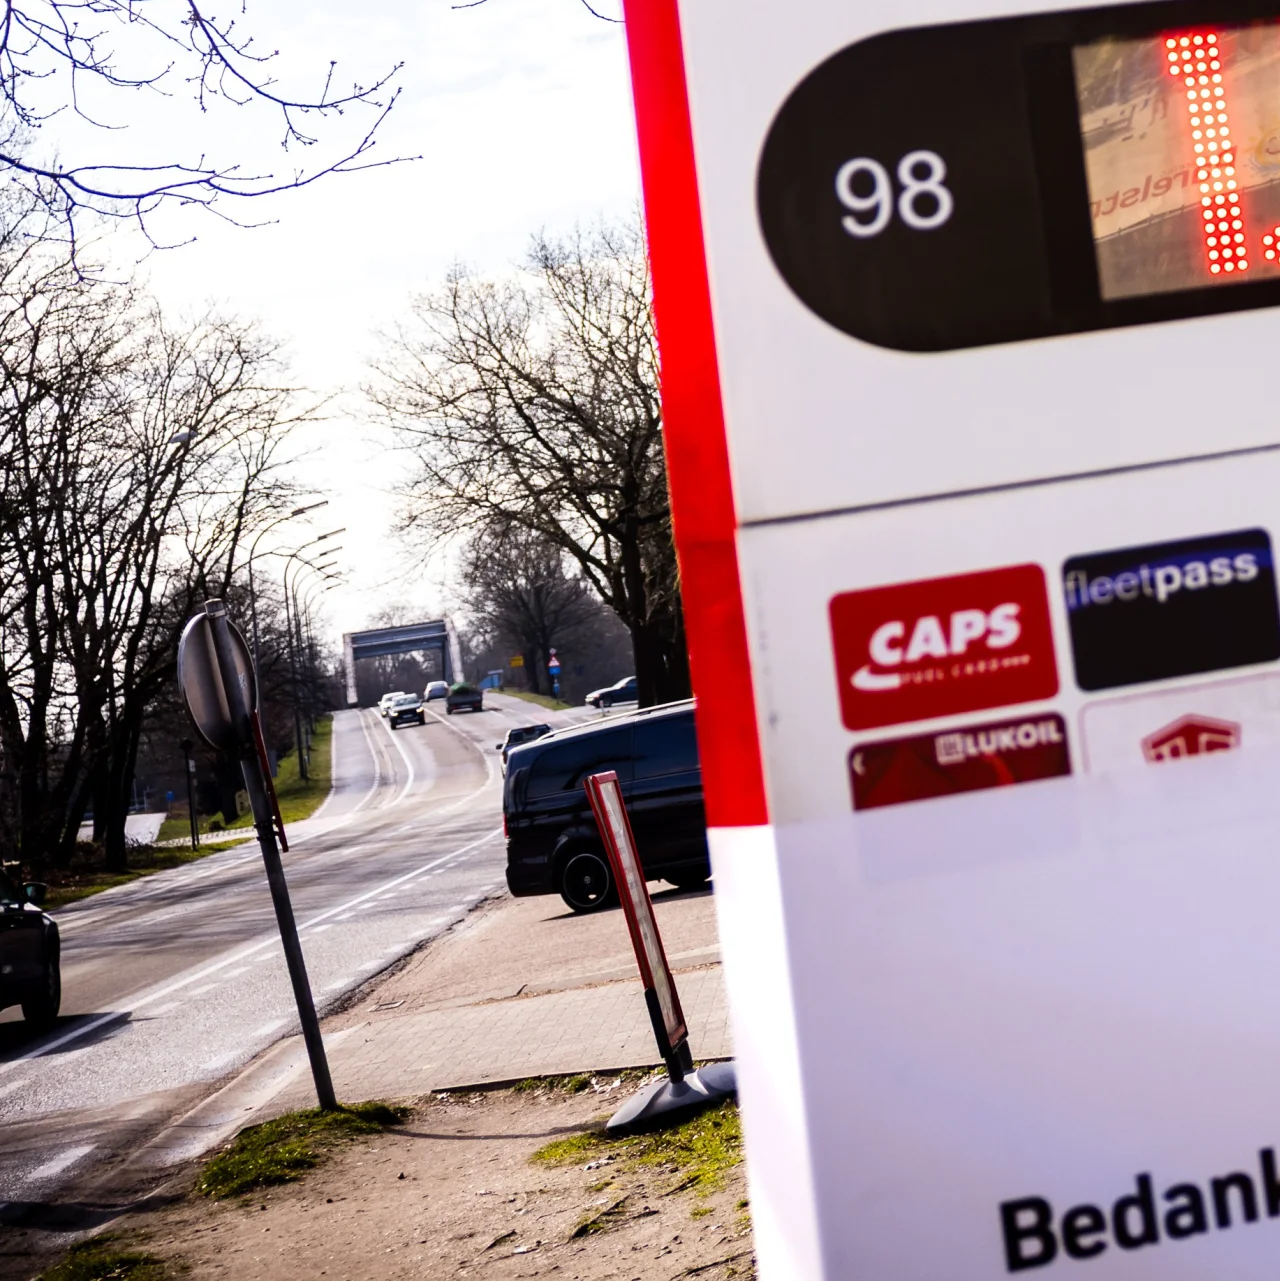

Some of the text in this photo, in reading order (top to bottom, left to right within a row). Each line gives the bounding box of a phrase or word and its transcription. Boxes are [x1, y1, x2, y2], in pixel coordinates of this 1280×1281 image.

[834, 149, 955, 238] 98
[1065, 552, 1259, 609] fleetpass
[869, 603, 1021, 666] CAPS
[964, 719, 1063, 756] LUKOIL
